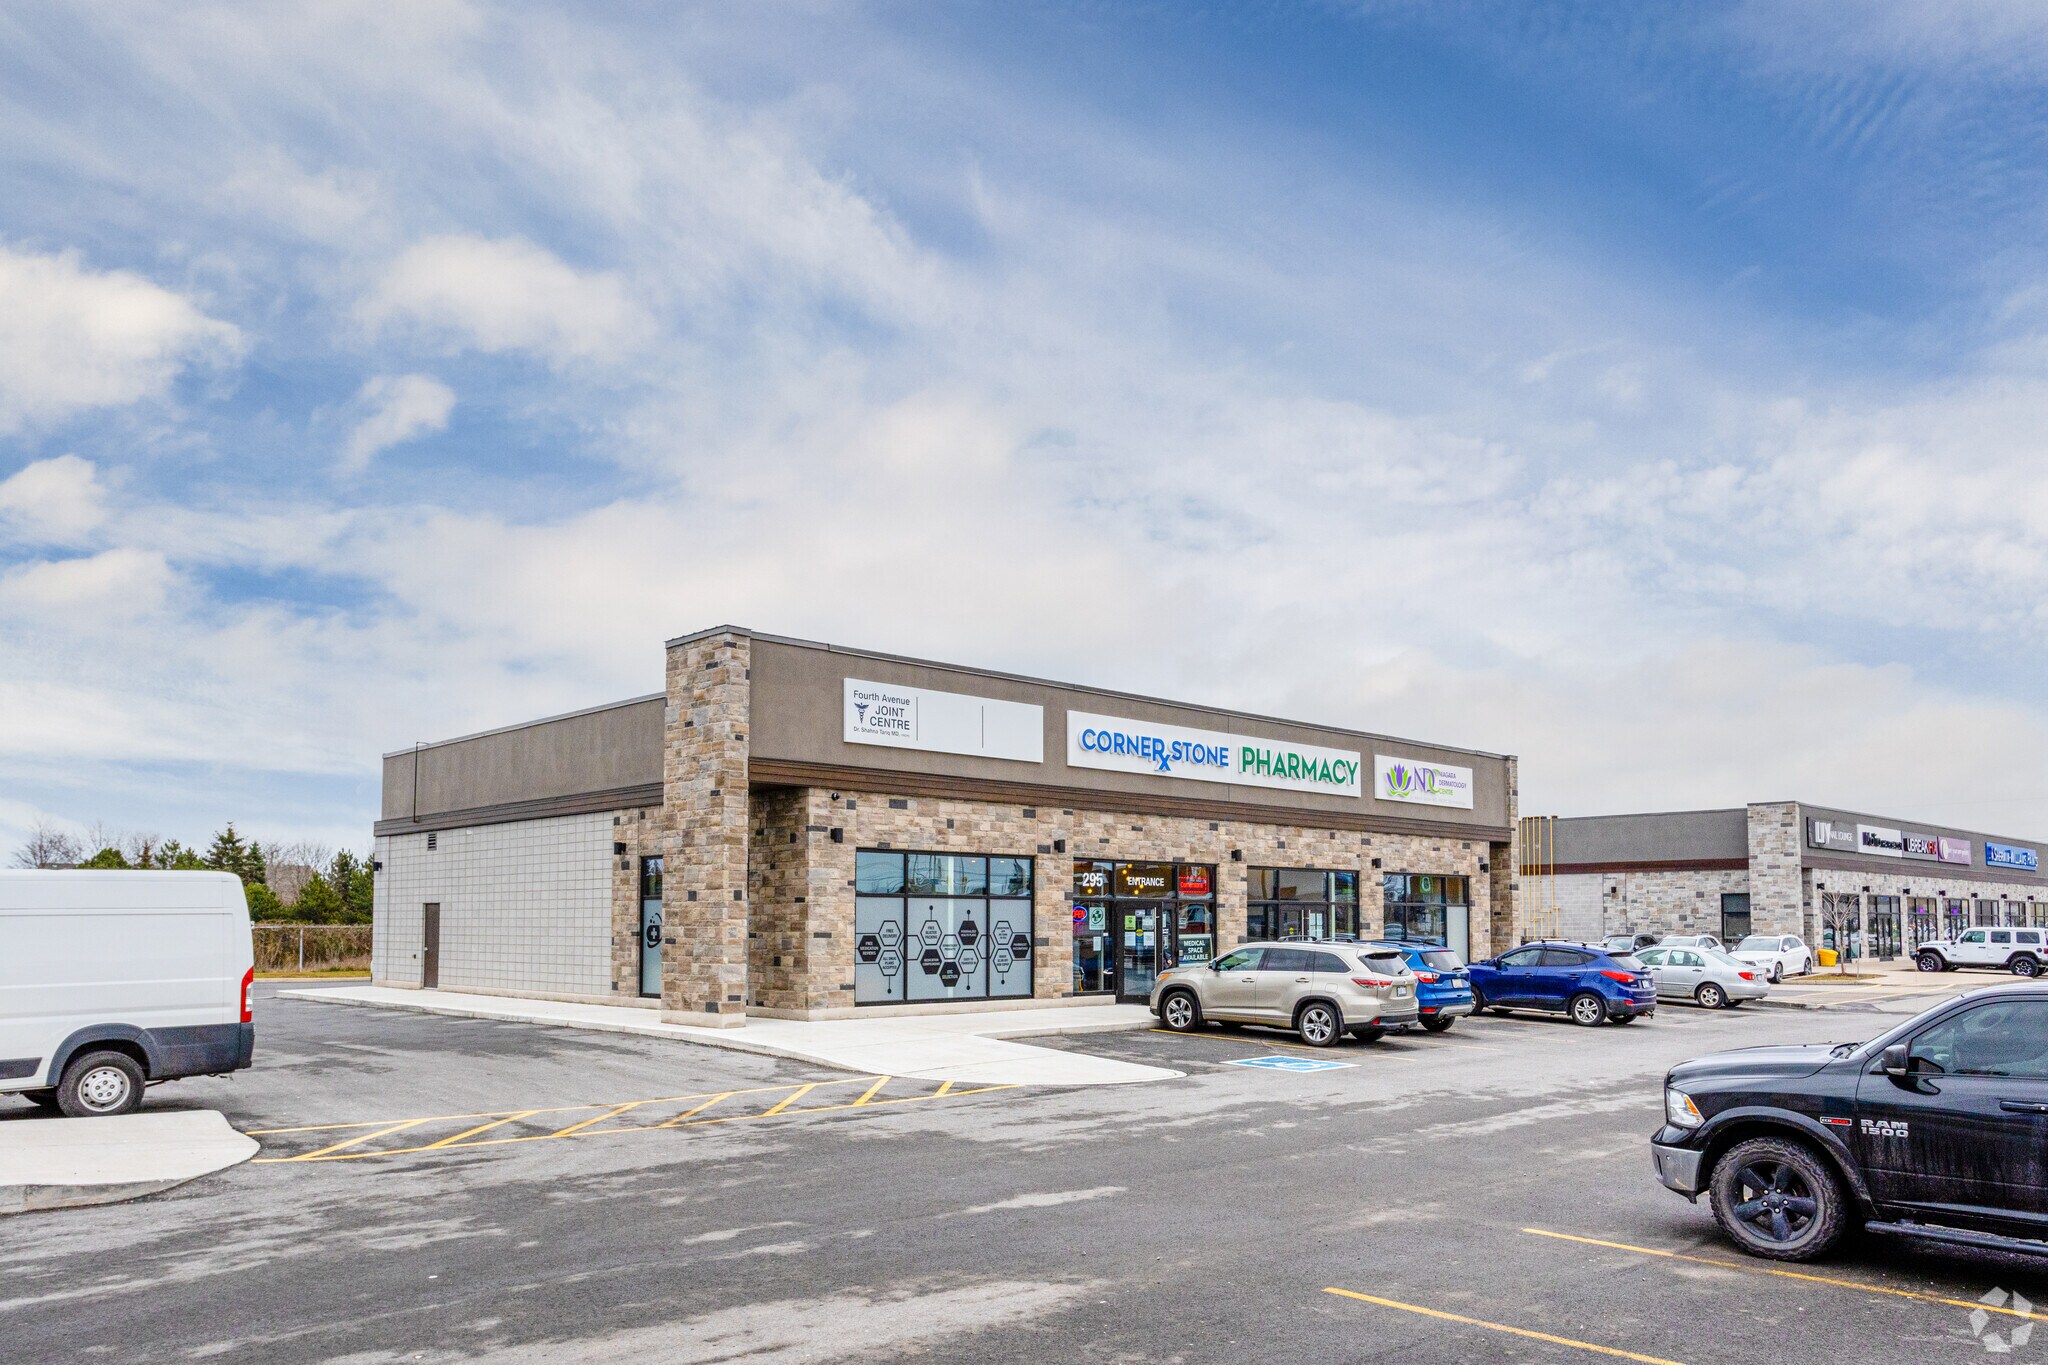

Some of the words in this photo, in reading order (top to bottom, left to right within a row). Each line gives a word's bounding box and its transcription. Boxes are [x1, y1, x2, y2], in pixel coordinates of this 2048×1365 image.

[853, 690, 880, 701] Fourth
[881, 694, 910, 705] Avenue
[875, 705, 905, 718] JOINT
[870, 716, 910, 730] CENTRE
[1241, 746, 1359, 785] PHARMACY
[1439, 779, 1467, 789] DERMATOLOGY
[1082, 872, 1103, 887] 295
[1127, 876, 1165, 887] ENTRANCE
[1860, 1118, 1908, 1130] RAM
[1861, 1127, 1908, 1138] 1500
